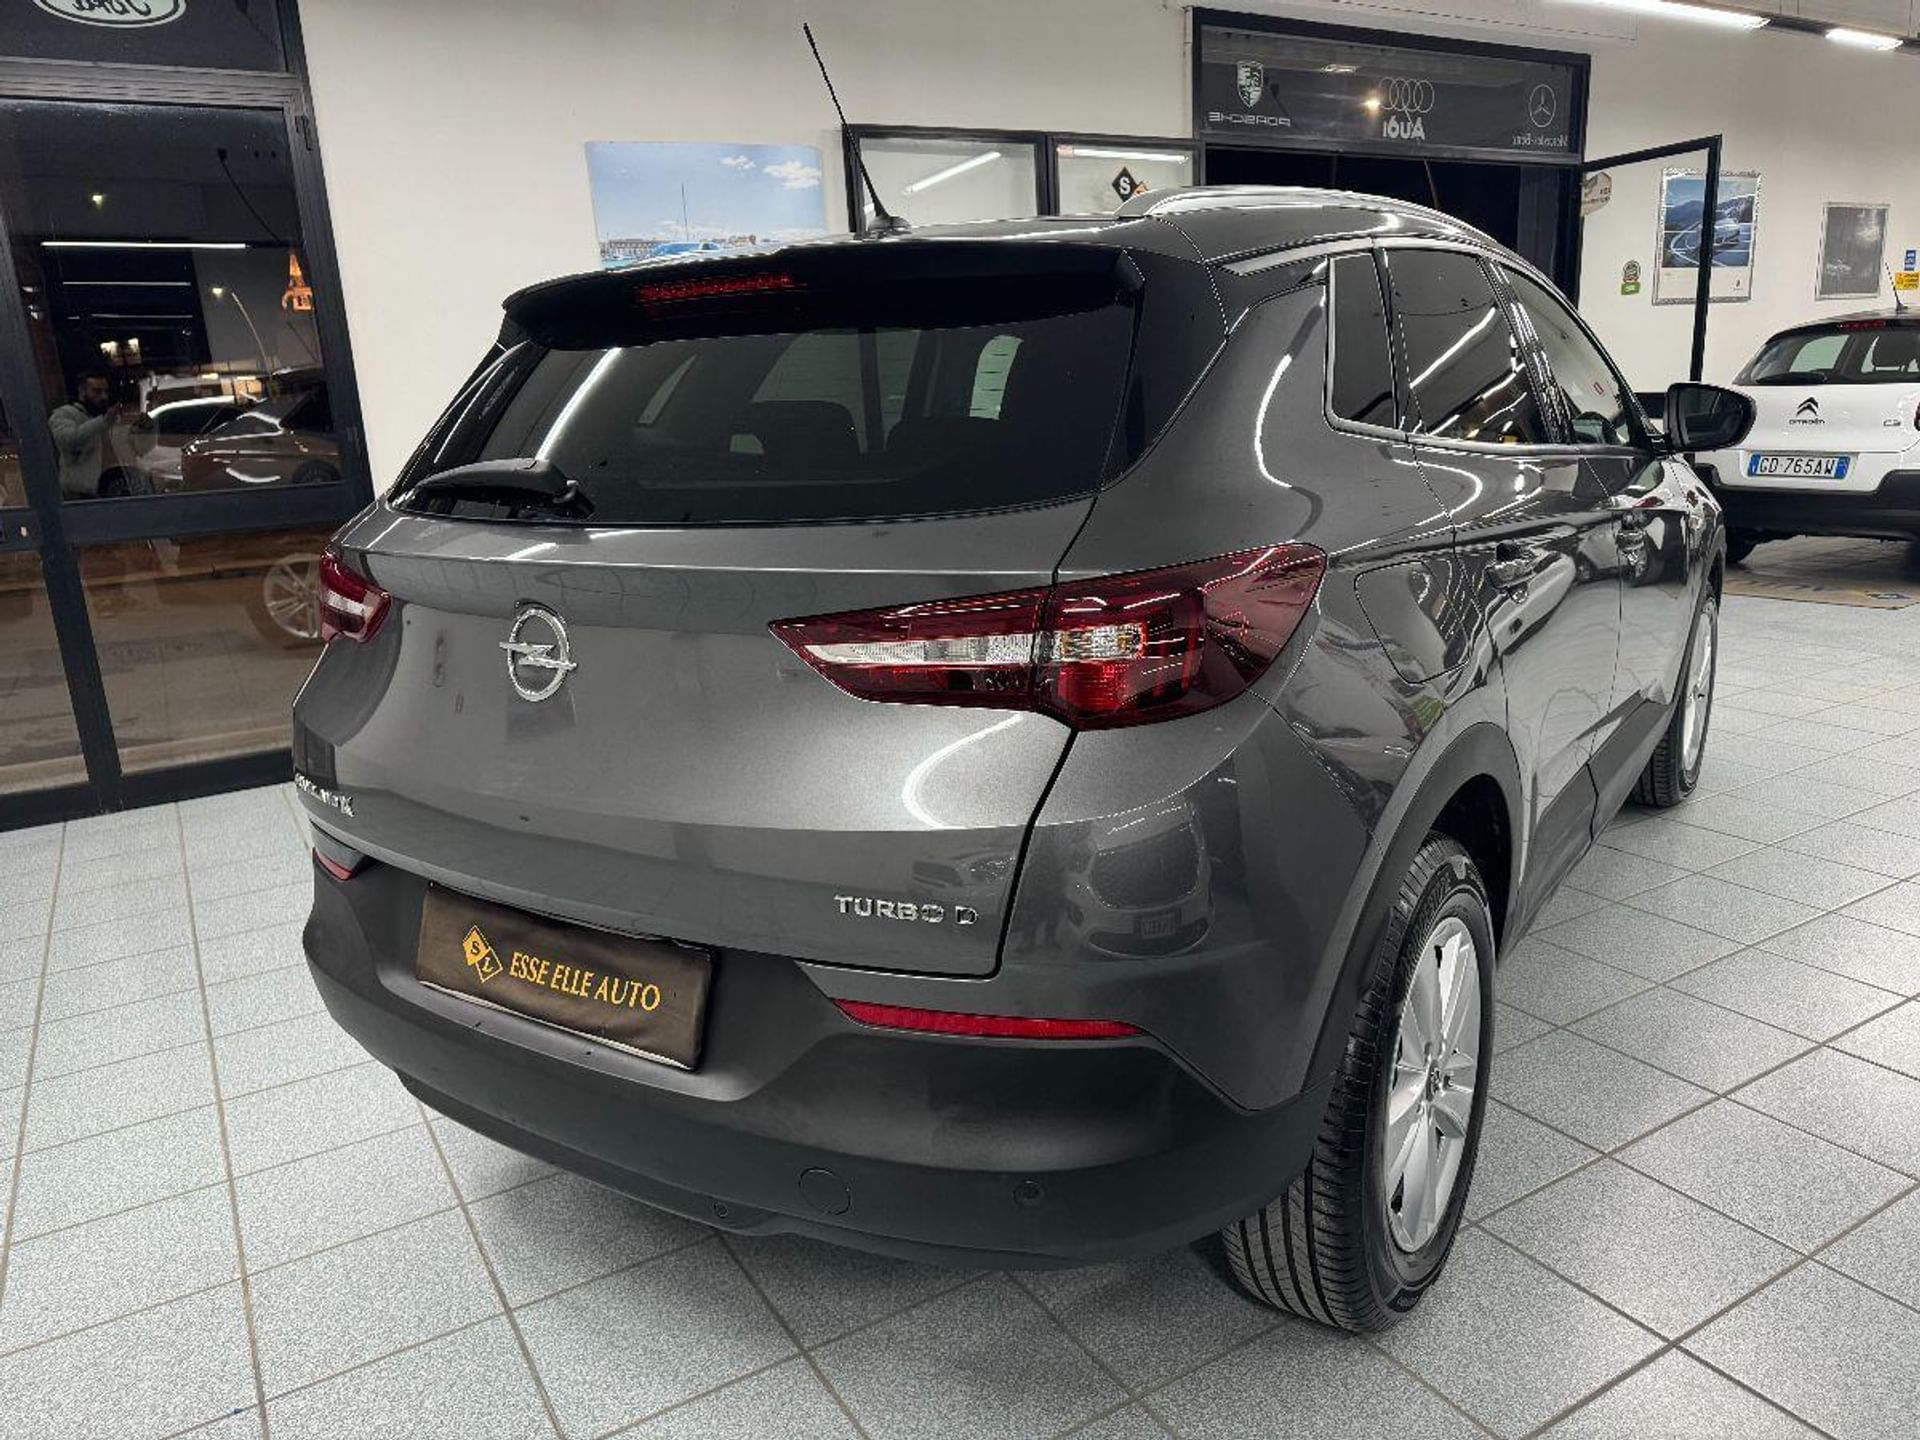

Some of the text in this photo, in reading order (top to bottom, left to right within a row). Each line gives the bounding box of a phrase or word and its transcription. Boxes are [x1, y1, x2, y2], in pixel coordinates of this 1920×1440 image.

[833, 894, 979, 926] TURBO D
[508, 950, 663, 1012] ESSE ELLE AUTO
